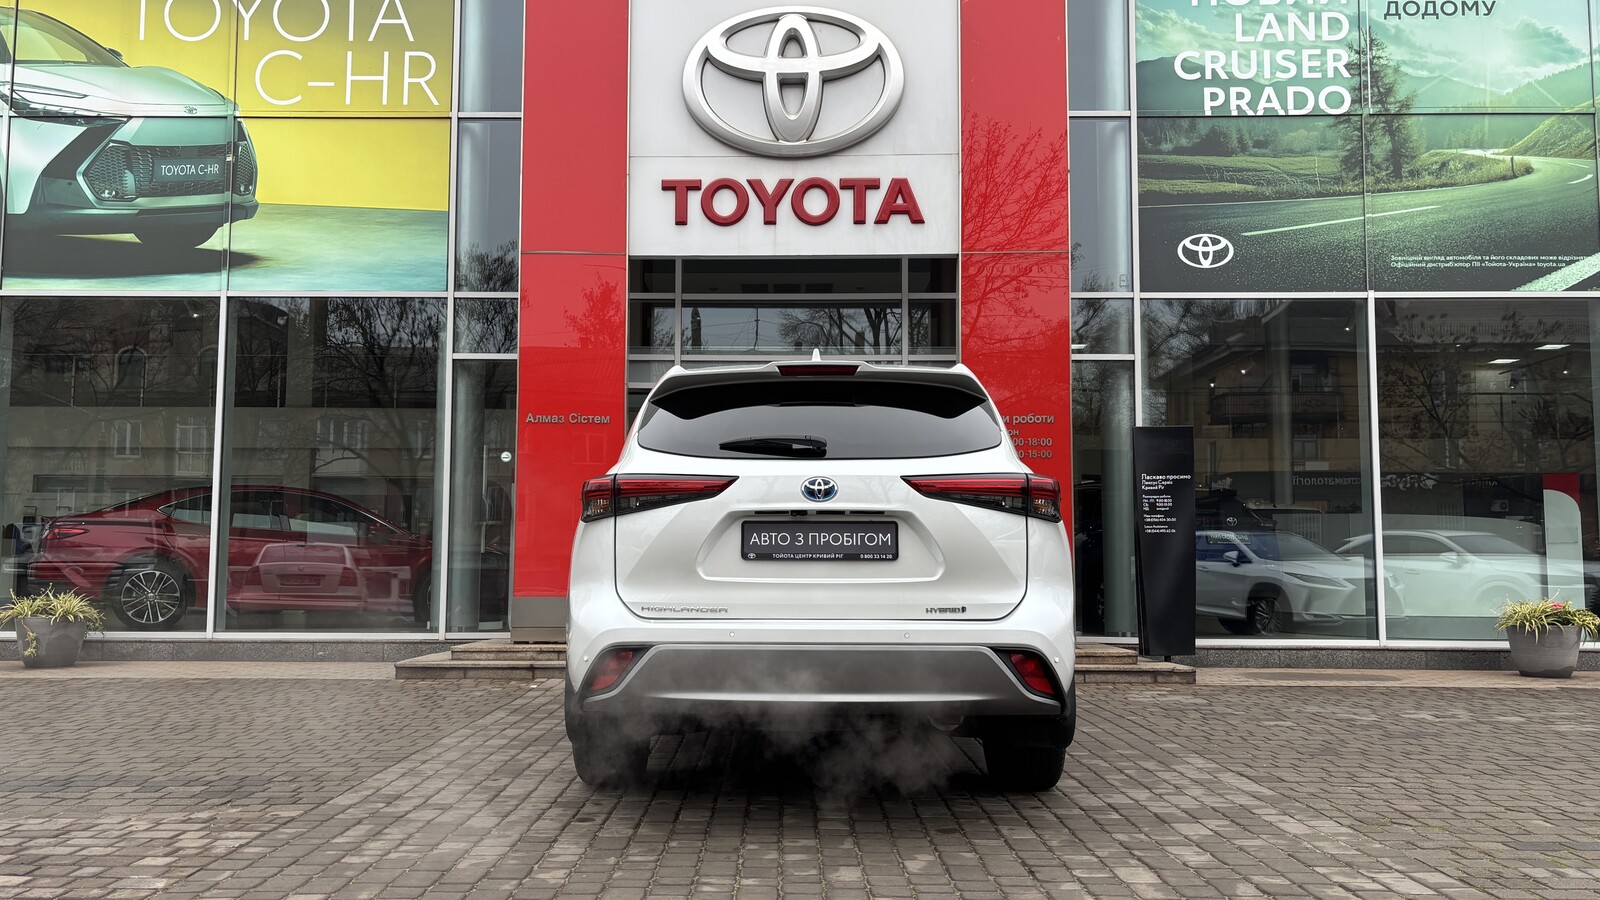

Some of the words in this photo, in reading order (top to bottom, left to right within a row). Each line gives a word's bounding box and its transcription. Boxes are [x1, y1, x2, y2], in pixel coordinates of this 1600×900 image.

[1383, 0, 1496, 20] ДОДОМУ
[1235, 12, 1350, 42] LAND
[1173, 49, 1352, 80] CRUISER
[255, 50, 440, 105] C-HR
[1203, 86, 1352, 116] PRADO
[161, 165, 196, 176] TOYOTA
[198, 164, 219, 174] C-HR
[661, 177, 925, 226] TOYOTA
[525, 413, 565, 423] Алмаз
[569, 413, 610, 423] Сістем
[1013, 413, 1054, 425] роботи
[1013, 437, 1052, 446] 00-18:00
[1018, 450, 1052, 458] 0-15:00
[750, 533, 791, 546] АВТО
[795, 533, 804, 546] З
[808, 533, 891, 546] ПРОБІГОМ
